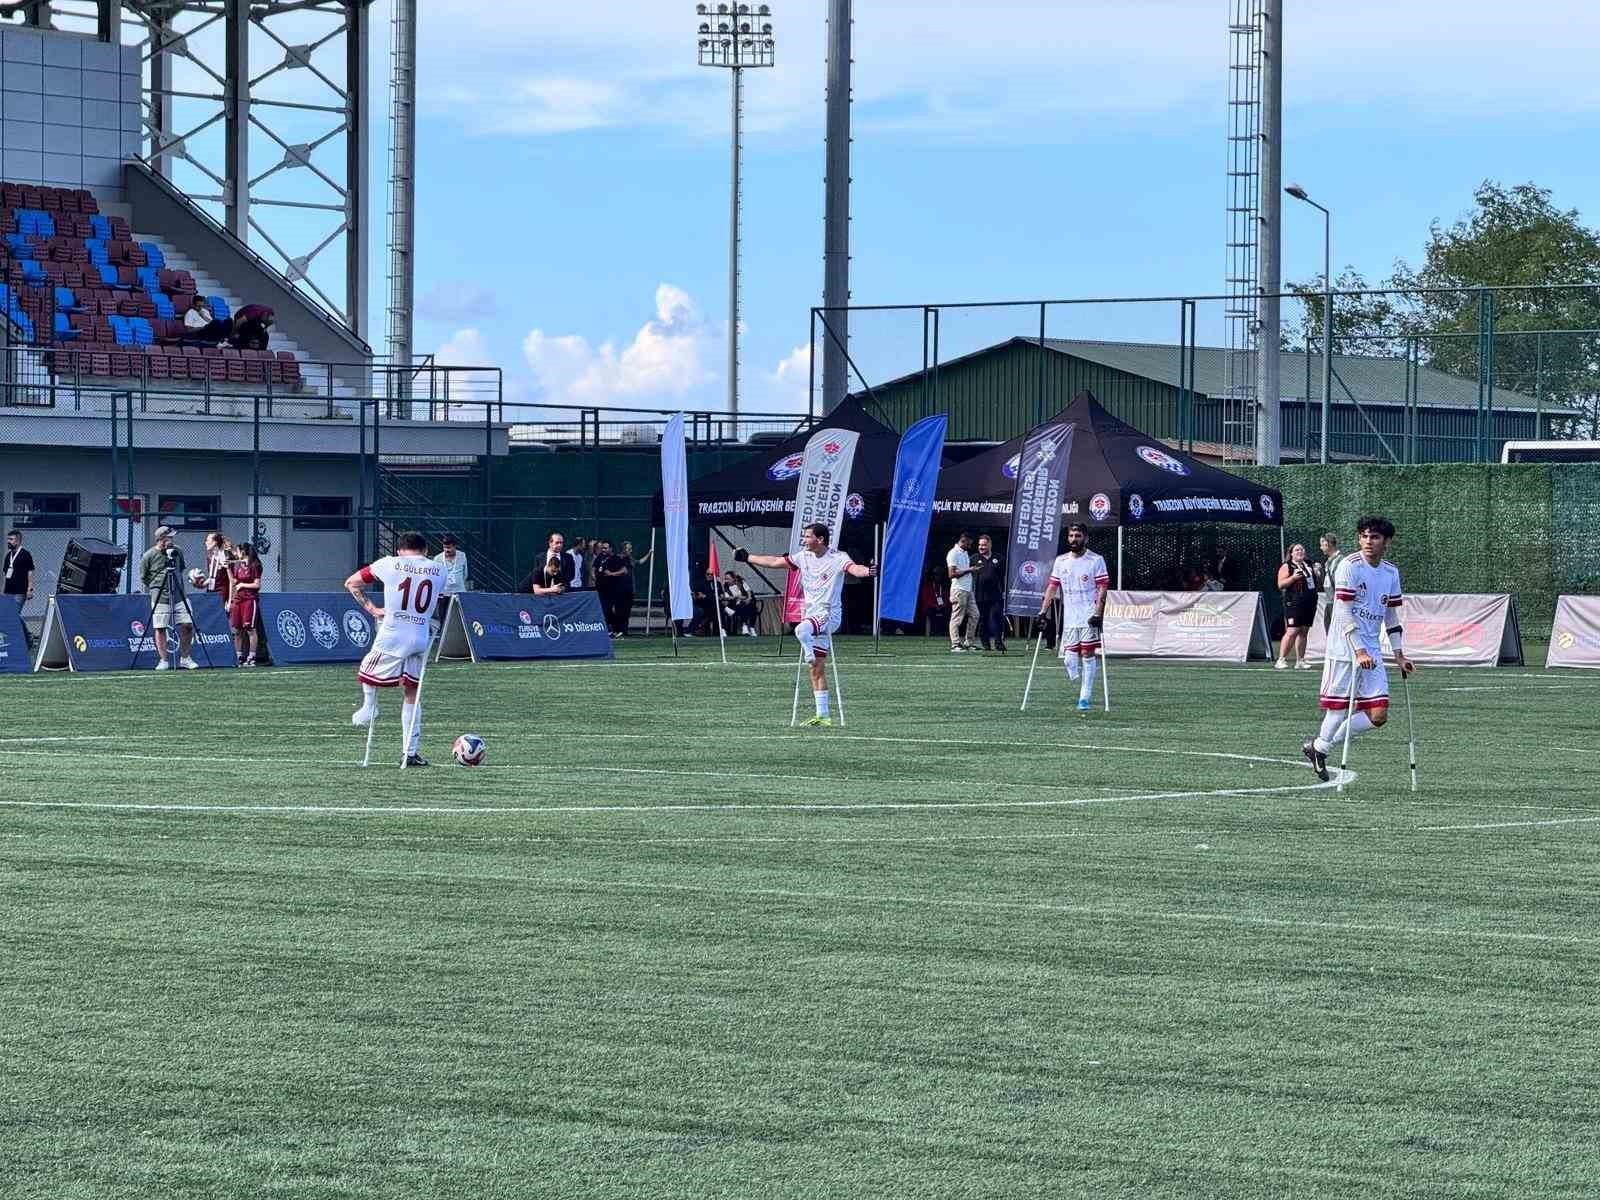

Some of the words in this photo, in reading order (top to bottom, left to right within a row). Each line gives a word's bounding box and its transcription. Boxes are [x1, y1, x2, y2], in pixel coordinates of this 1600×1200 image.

[699, 501, 733, 513] TRABZON
[735, 497, 784, 514] BÜYÜKŞEHİR
[932, 499, 952, 513] NÇLİK
[952, 502, 962, 512] VE
[962, 502, 979, 513] SPOR
[398, 577, 433, 614] 10
[575, 621, 605, 632] bitexen
